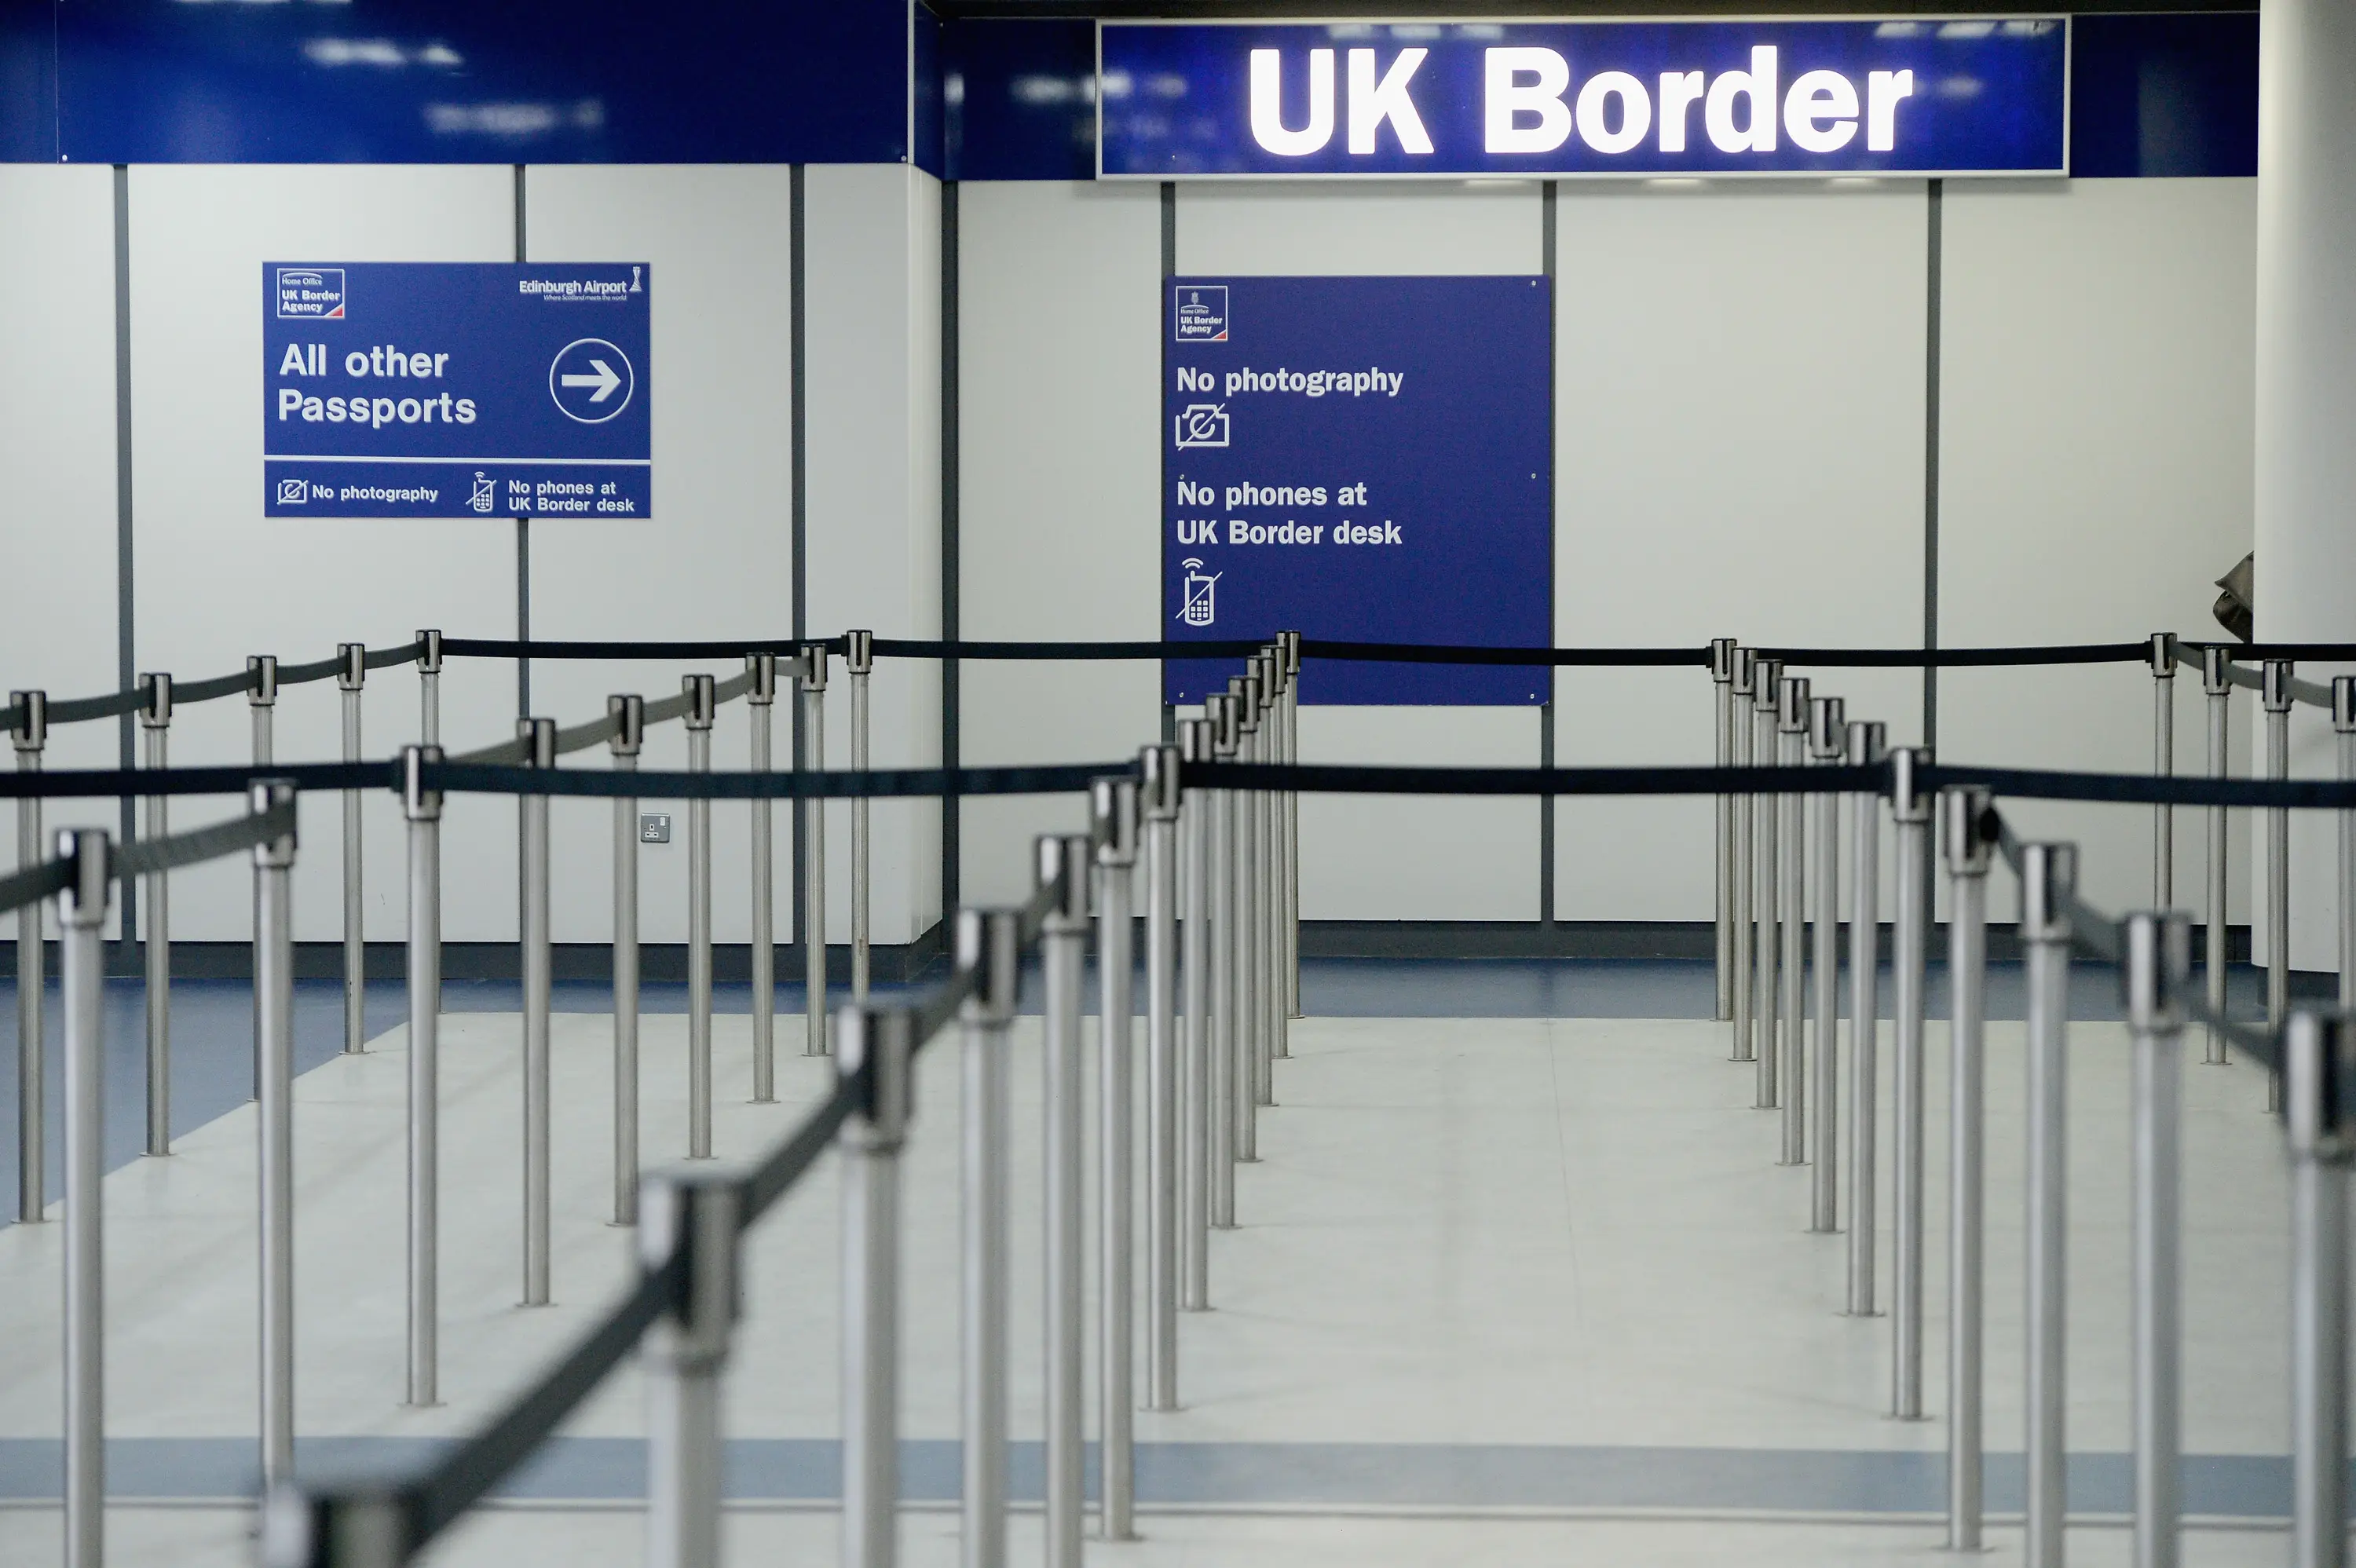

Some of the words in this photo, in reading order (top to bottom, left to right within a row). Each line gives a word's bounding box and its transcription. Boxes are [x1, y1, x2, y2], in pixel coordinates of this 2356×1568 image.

[1249, 47, 1435, 155] UK
[1484, 45, 1914, 155] Border
[282, 290, 298, 300] UK
[302, 290, 341, 301] Border
[519, 280, 581, 294] Edinburgh
[584, 280, 627, 294] Airport
[282, 301, 323, 313] Agency
[1180, 325, 1212, 334] Agency
[279, 343, 327, 376] All
[345, 345, 449, 378] other
[1177, 367, 1216, 392] No
[1226, 367, 1404, 397] photography
[278, 389, 477, 429] Passports
[312, 485, 335, 499] No
[340, 486, 439, 503] photography
[509, 480, 530, 495] No
[537, 481, 594, 495] phones
[601, 481, 616, 495] at
[1177, 481, 1216, 506] No
[1226, 481, 1328, 510] phones
[1337, 482, 1367, 506] at
[509, 497, 532, 511] UK
[537, 498, 591, 512] Border
[597, 499, 635, 512] desk
[1177, 520, 1219, 544] UK
[1229, 520, 1324, 544] Border
[1333, 520, 1403, 544] desk
